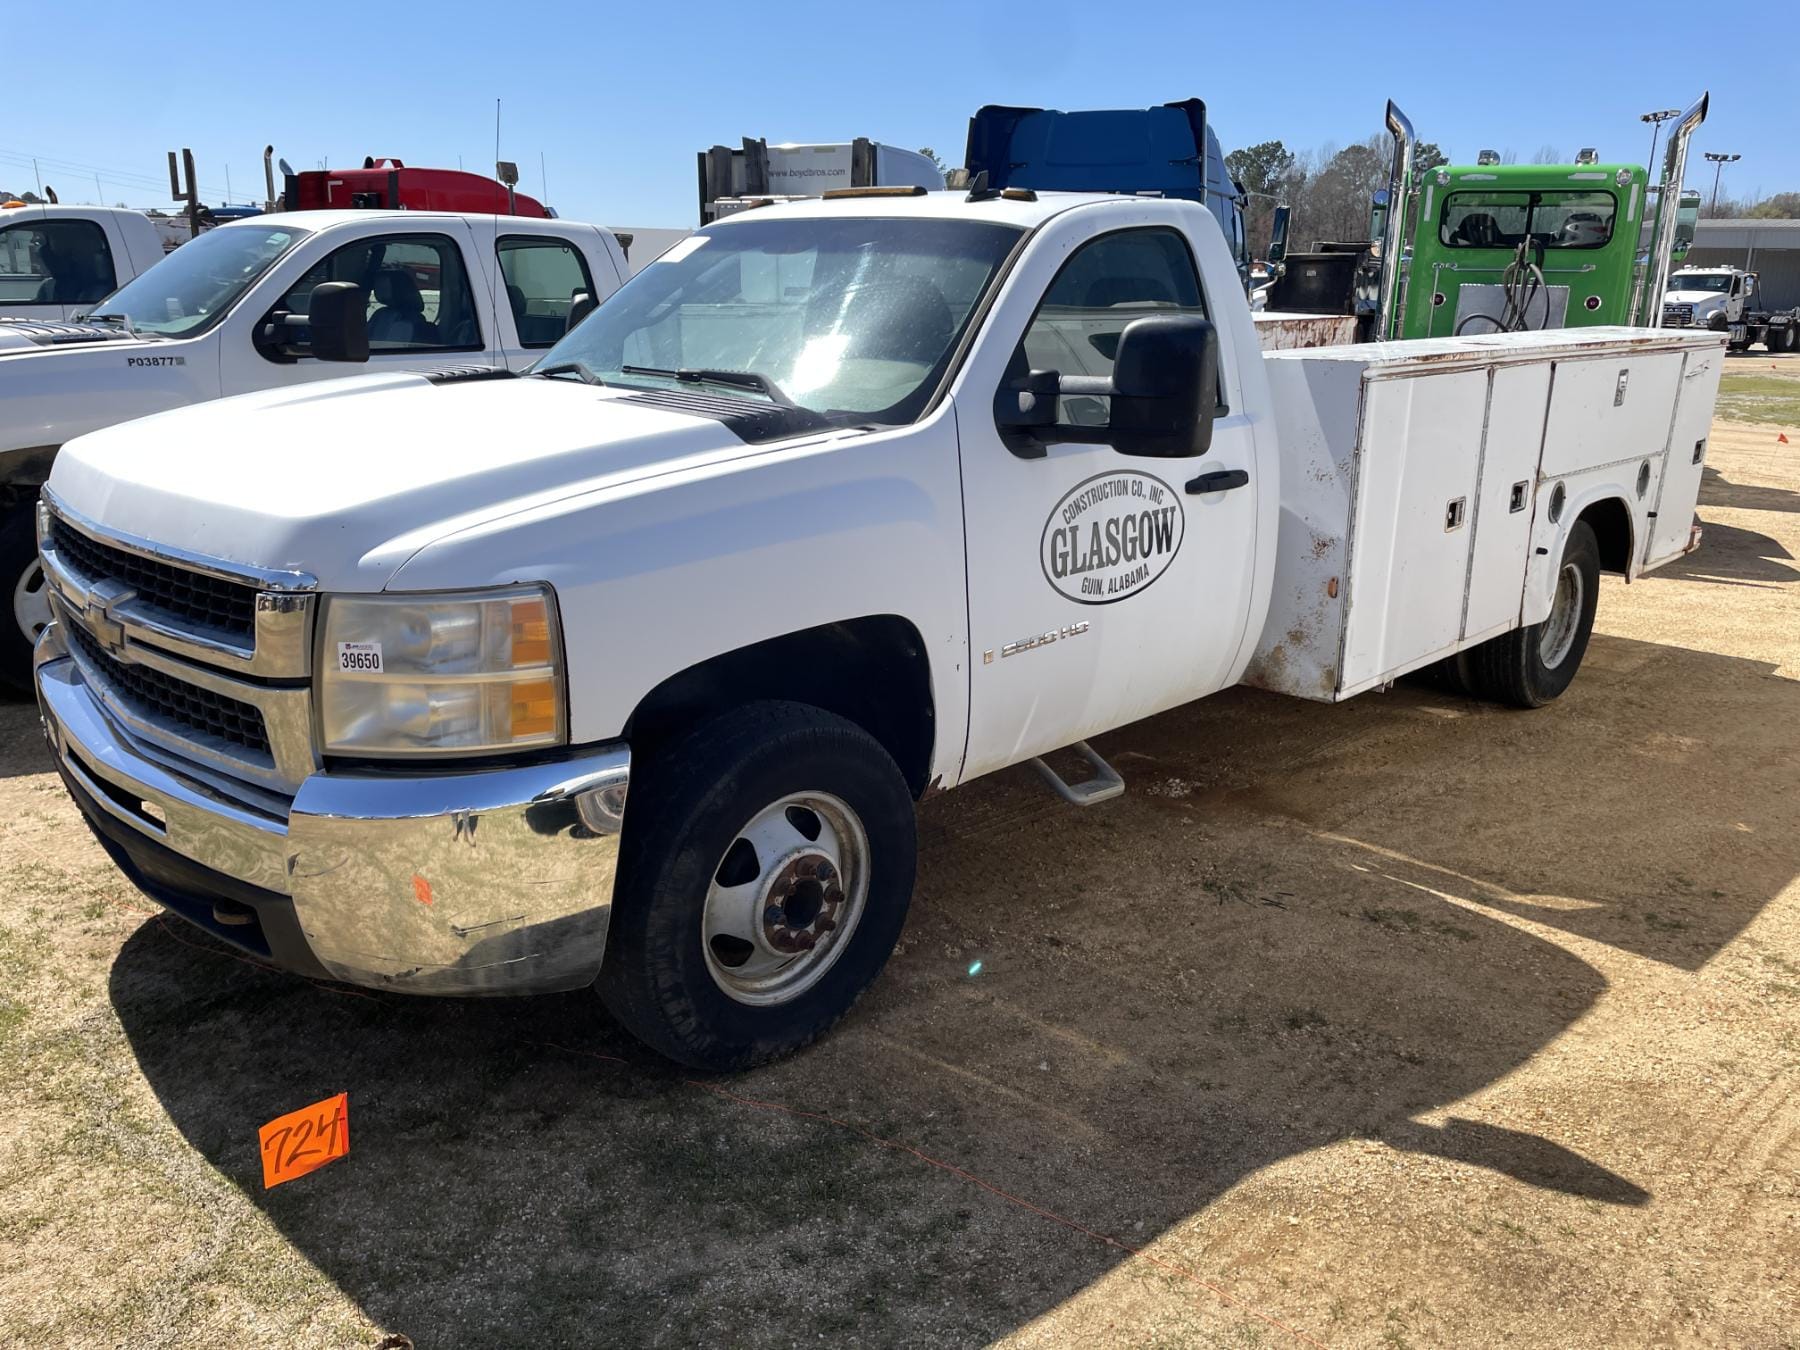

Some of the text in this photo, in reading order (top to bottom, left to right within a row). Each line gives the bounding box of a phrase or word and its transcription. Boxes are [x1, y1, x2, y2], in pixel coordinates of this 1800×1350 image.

[127, 356, 174, 367] P03877
[1062, 479, 1129, 525] CONSTRUCTION
[1050, 505, 1177, 579] GLASGOW
[1081, 563, 1150, 597] GUIN, ALABAMA
[341, 652, 380, 669] 39650
[264, 1107, 346, 1175] 724
